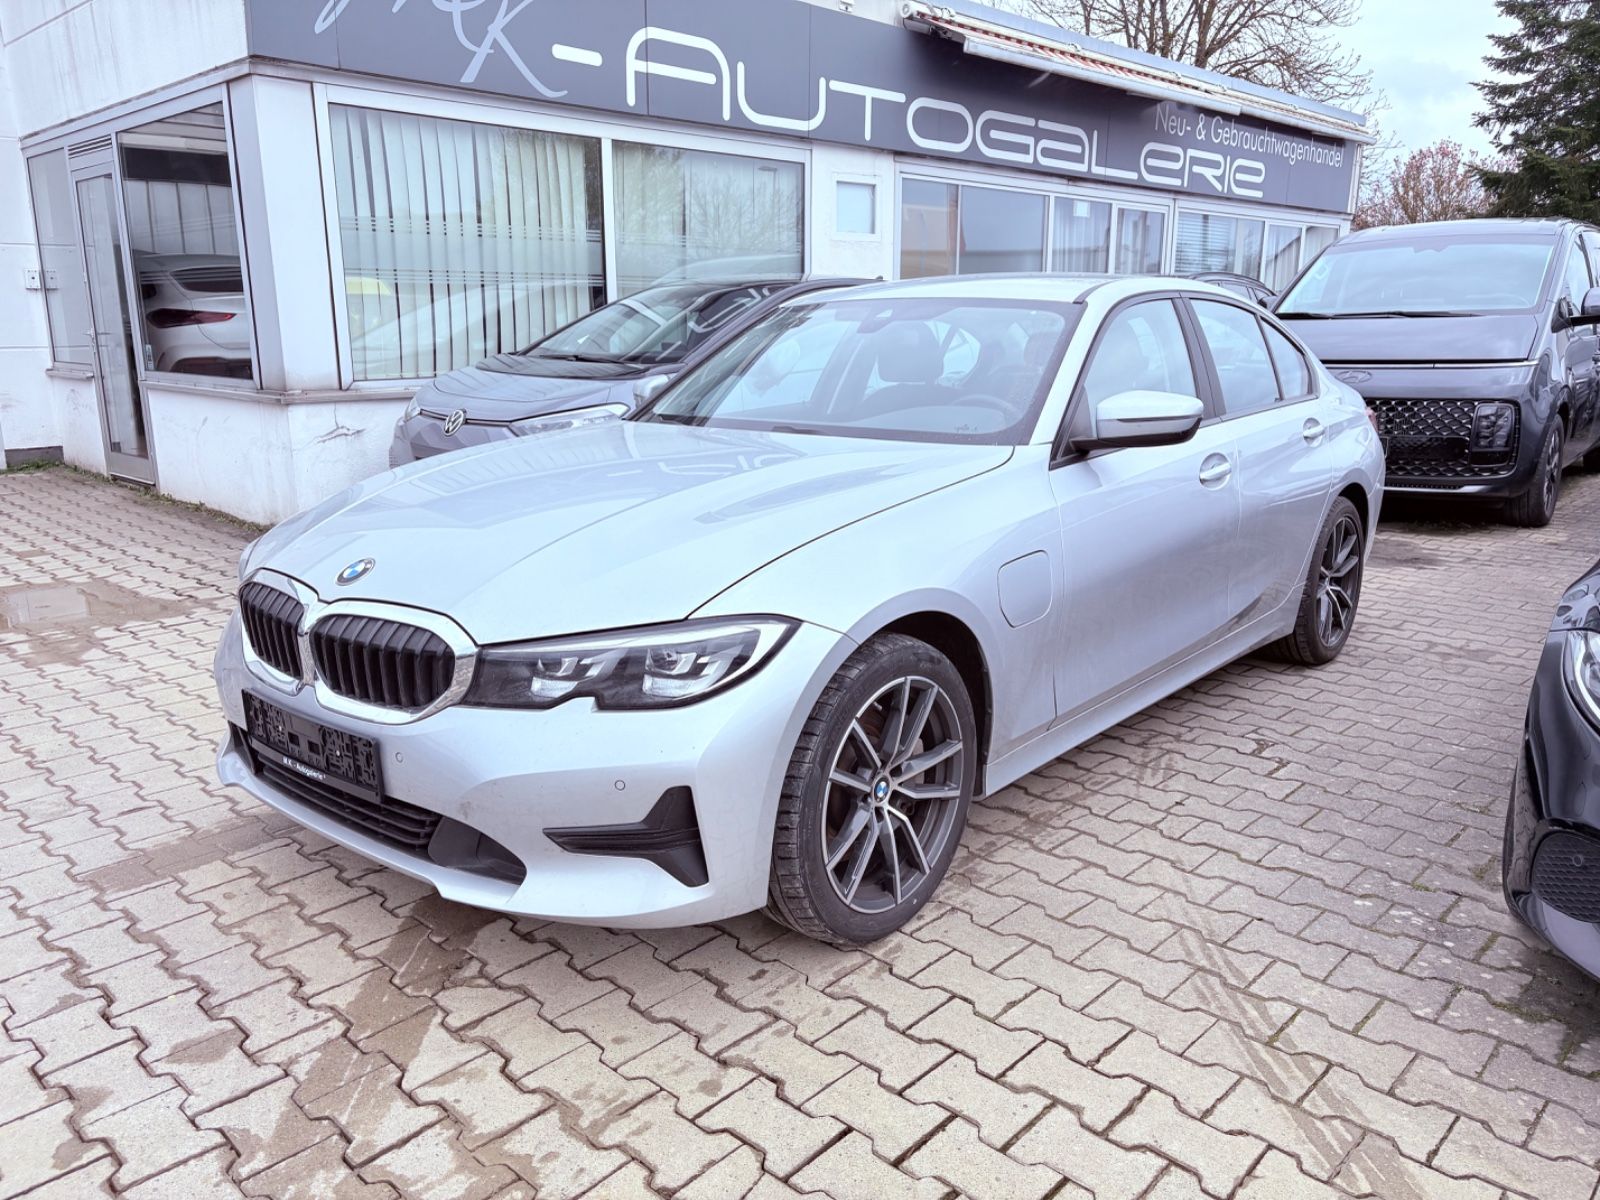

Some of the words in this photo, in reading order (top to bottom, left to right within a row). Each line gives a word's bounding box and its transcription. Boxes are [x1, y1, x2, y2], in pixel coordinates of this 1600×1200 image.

[1154, 103, 1191, 137] Neu-
[1195, 112, 1207, 141] &
[1210, 115, 1345, 167] Gebrauchtwagenhandel
